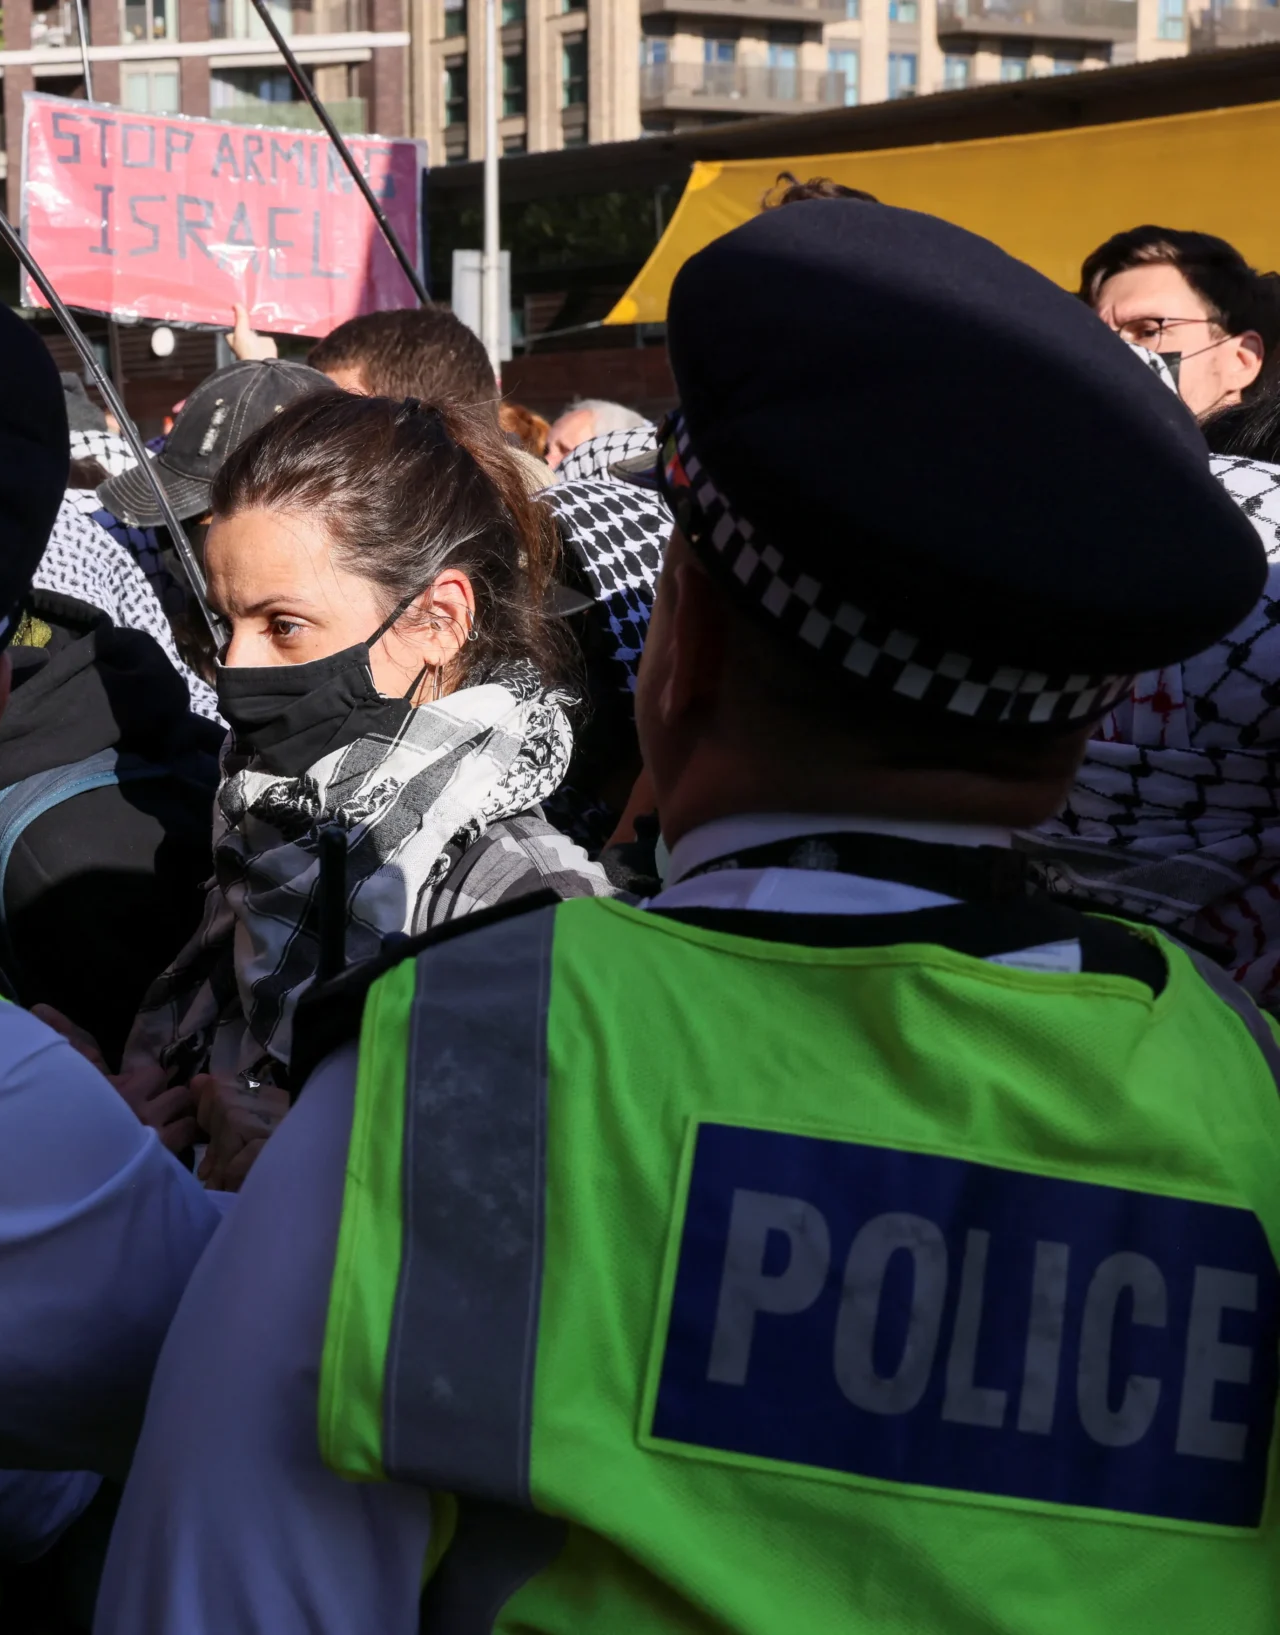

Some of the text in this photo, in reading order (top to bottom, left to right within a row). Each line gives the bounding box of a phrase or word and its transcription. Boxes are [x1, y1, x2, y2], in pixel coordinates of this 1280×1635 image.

[52, 112, 195, 172] STOP
[89, 184, 348, 280] ISRAEL
[706, 1187, 1259, 1462] POLICE
